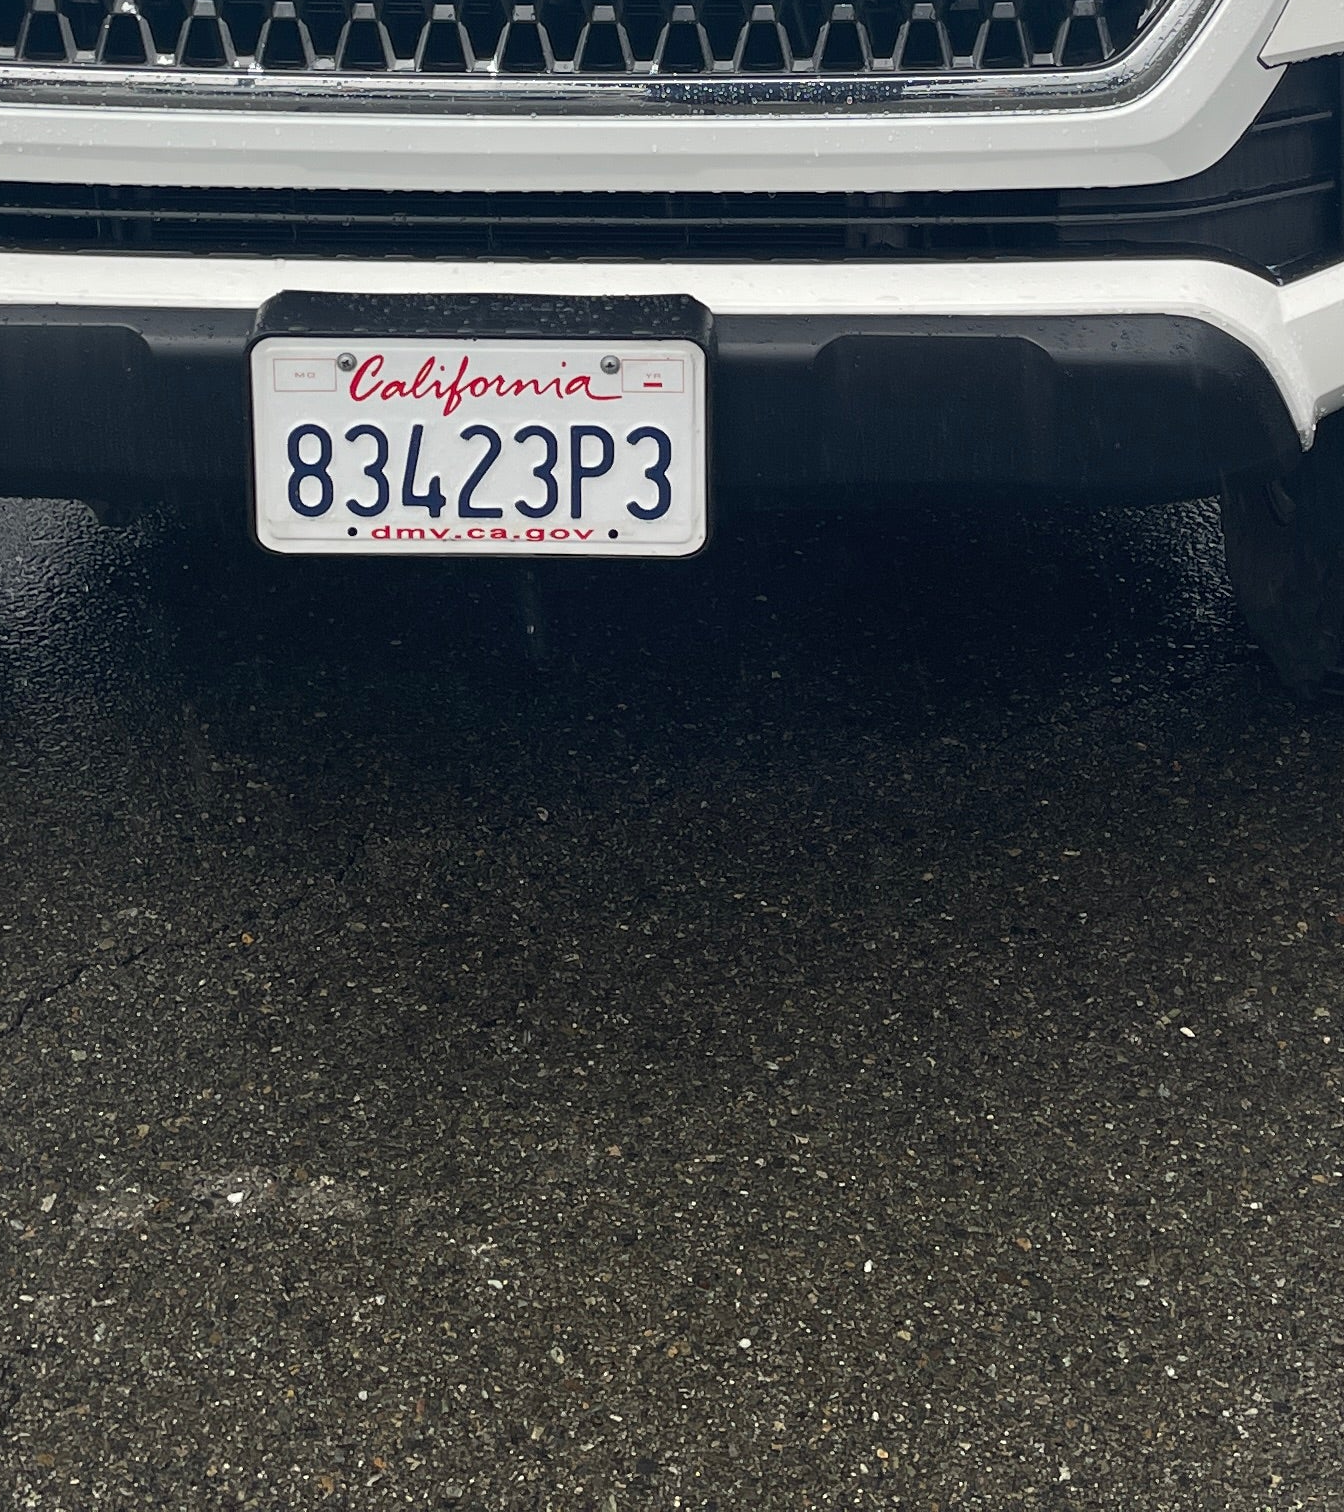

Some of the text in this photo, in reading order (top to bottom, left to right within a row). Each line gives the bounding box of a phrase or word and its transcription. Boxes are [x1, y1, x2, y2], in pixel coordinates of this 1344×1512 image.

[349, 354, 622, 416] California
[287, 424, 672, 520] 83423P3
[371, 525, 594, 541] dmv.ca.gov
